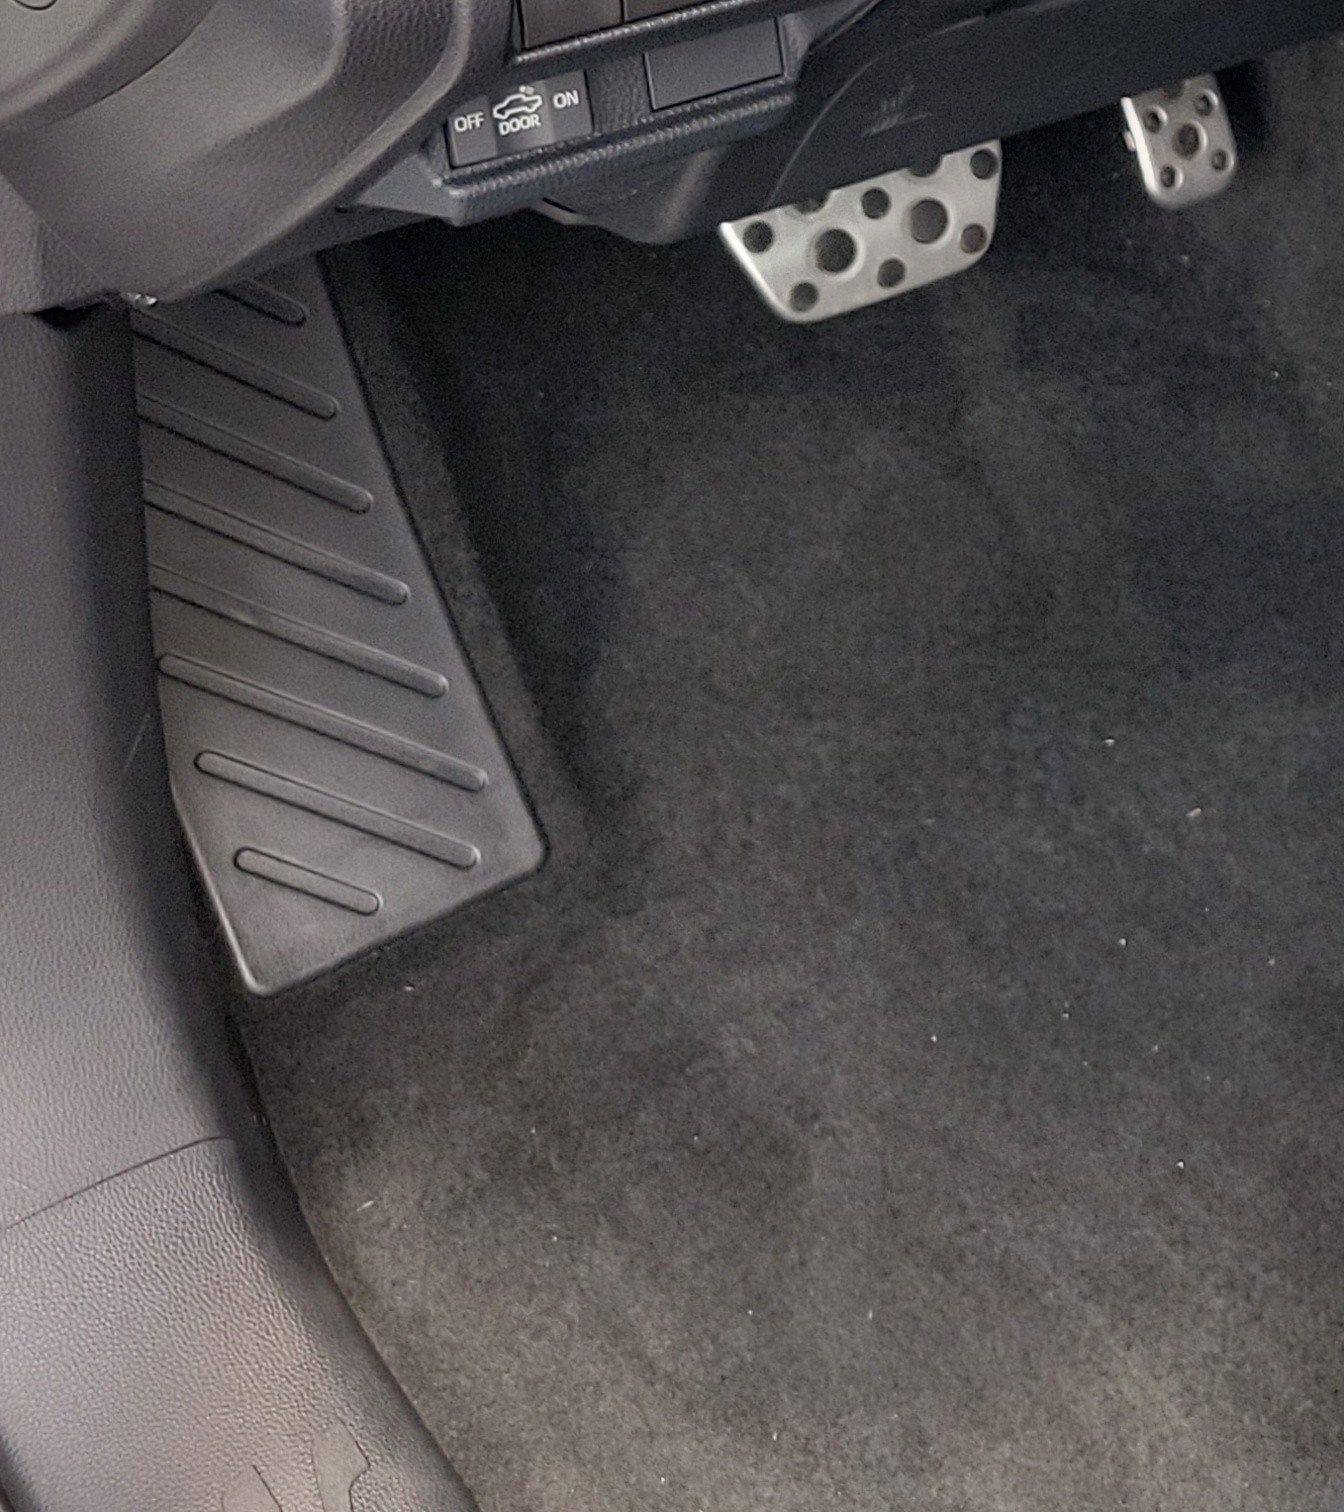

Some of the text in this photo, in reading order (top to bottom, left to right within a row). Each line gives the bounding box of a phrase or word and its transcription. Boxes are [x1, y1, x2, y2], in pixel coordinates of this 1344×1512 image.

[552, 89, 580, 109] ON
[454, 111, 485, 133] OFF
[498, 113, 542, 136] DOOR
